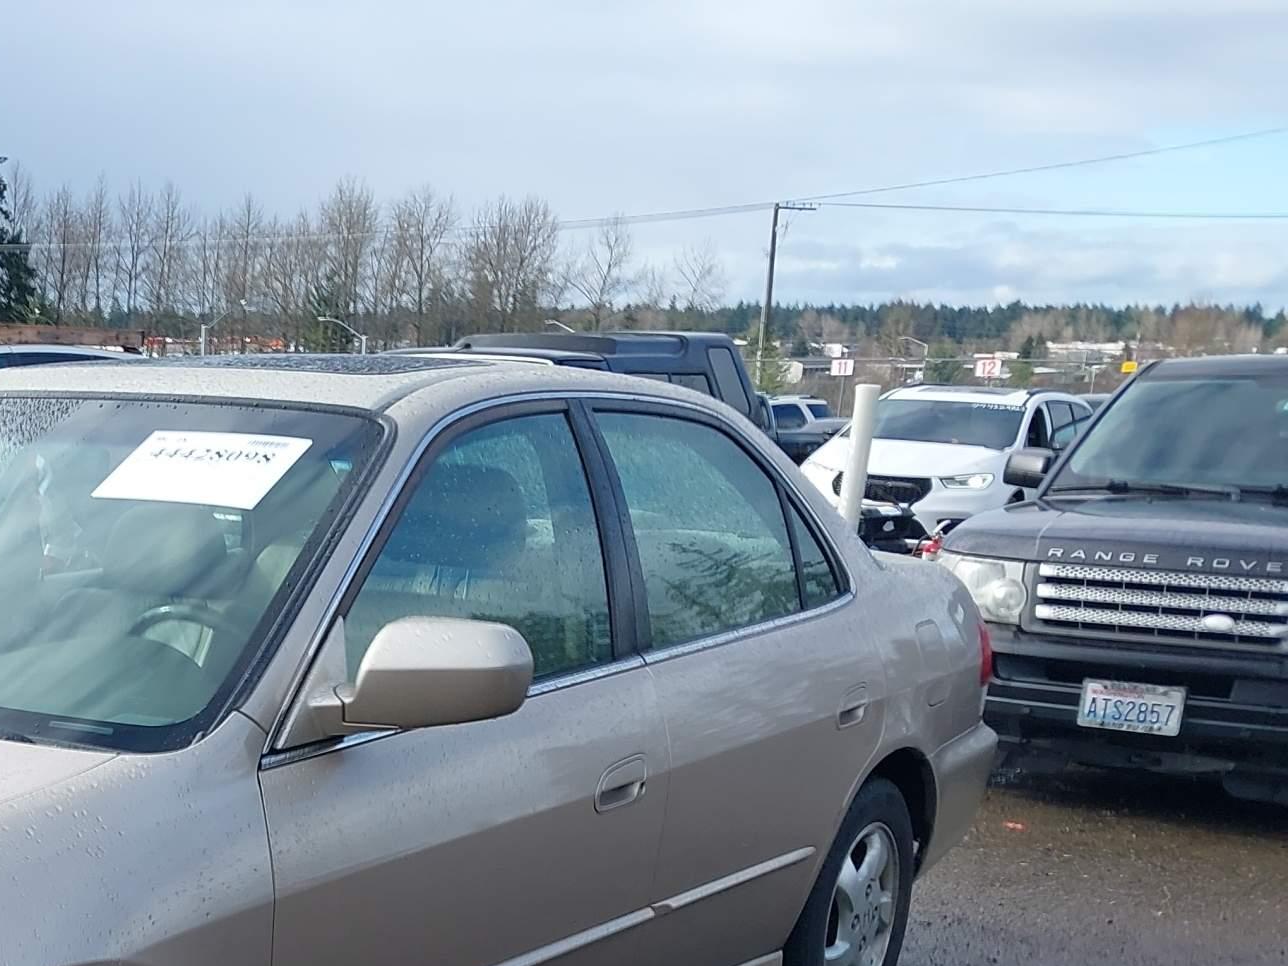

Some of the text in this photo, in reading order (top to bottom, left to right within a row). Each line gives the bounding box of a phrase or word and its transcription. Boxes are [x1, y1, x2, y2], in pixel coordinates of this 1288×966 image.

[836, 360, 849, 375] 11
[981, 361, 996, 376] 12
[1047, 547, 1160, 565] RANGE
[1086, 696, 1177, 727] ATS2857
